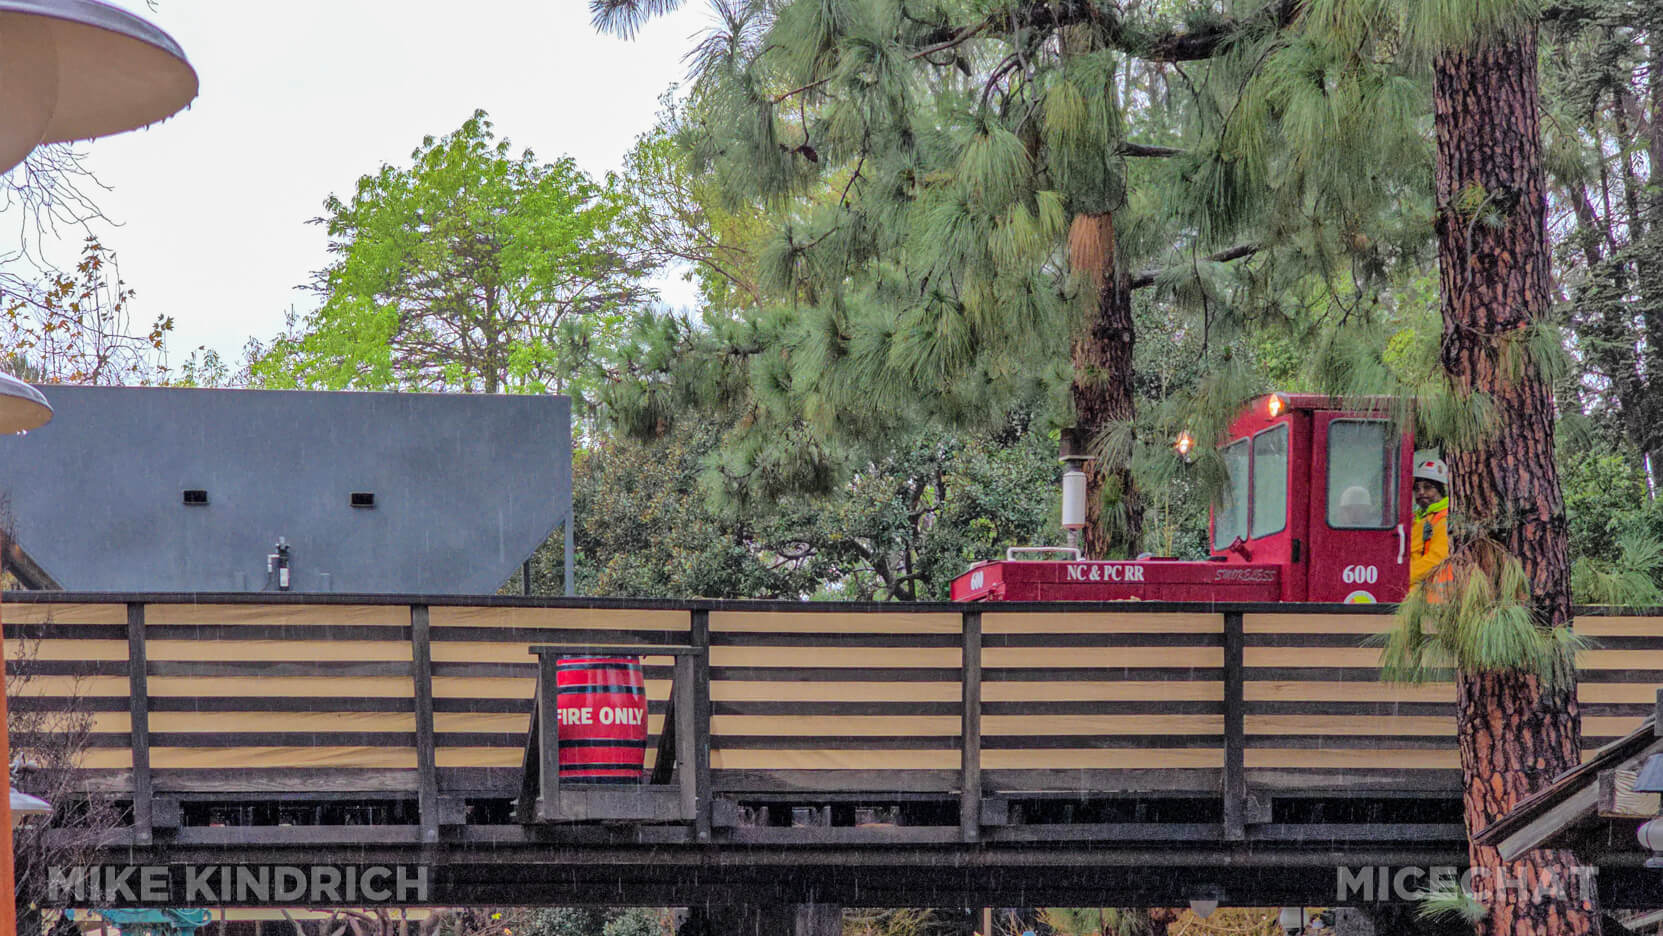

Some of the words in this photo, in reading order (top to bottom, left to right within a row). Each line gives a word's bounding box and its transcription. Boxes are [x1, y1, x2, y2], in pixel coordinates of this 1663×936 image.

[970, 570, 984, 590] 600
[1066, 564, 1087, 581] NC
[1089, 564, 1101, 581] &
[1103, 564, 1122, 581] PC
[1124, 564, 1145, 581] RR
[1342, 564, 1378, 584] 600
[599, 706, 644, 725] ONLY
